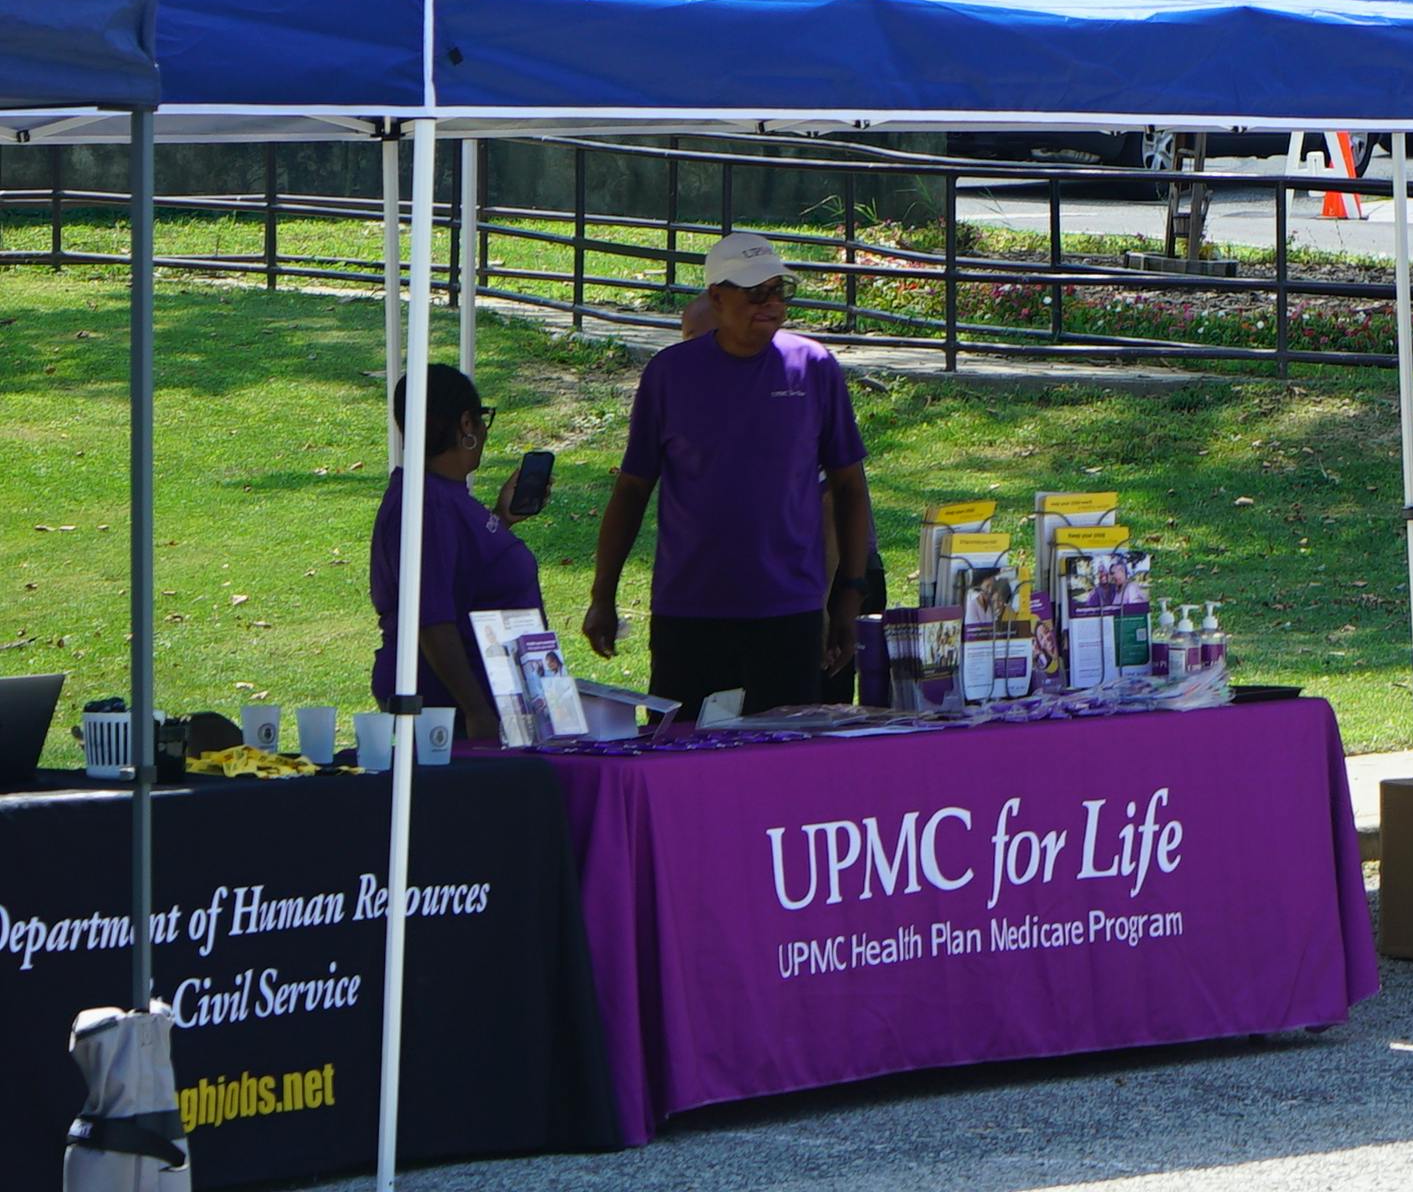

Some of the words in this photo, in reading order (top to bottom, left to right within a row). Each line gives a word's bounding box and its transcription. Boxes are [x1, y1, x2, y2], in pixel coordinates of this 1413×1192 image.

[765, 806, 975, 910] UPMC
[987, 797, 1067, 909] for
[1077, 787, 1184, 899] Life
[188, 886, 228, 956] of
[228, 885, 346, 936] Human
[352, 873, 491, 920] Reources
[778, 935, 847, 978] UPMC
[850, 923, 923, 966] Health
[930, 921, 982, 957] Plan
[990, 914, 1085, 952] Medicare
[1088, 909, 1183, 947] Program
[172, 968, 256, 1029] Civil
[254, 960, 361, 1019] Service
